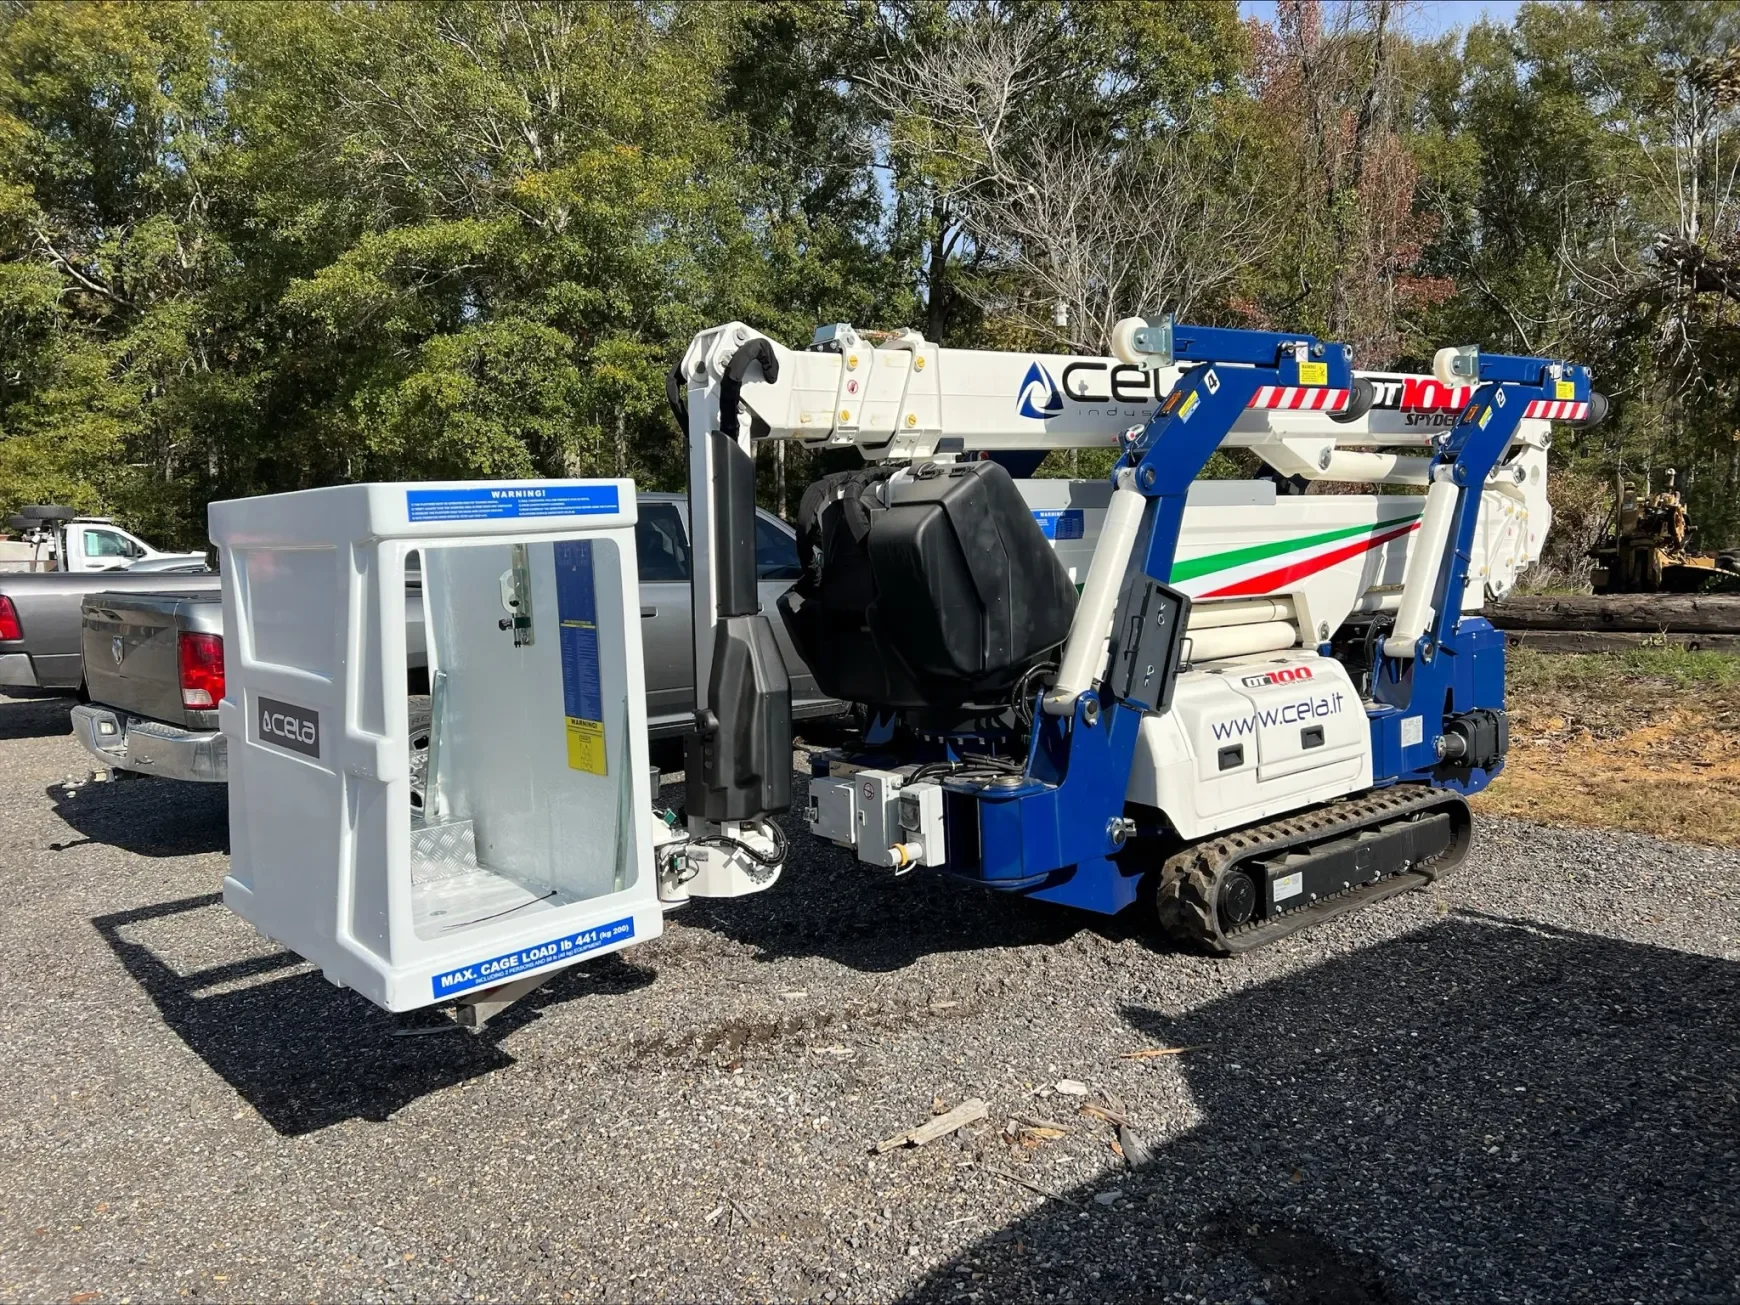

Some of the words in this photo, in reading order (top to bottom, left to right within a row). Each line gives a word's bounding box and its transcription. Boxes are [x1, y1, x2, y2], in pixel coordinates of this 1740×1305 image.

[1062, 361, 1194, 403] cel
[1208, 373, 1217, 389] 4
[1498, 391, 1504, 406] 2
[491, 489, 546, 499] WARNING!
[570, 719, 598, 728] WARNING!
[1212, 692, 1343, 740] www.cela.it
[441, 968, 478, 988] MAX.
[480, 955, 519, 975] CAGE
[522, 944, 558, 963] LOAD
[575, 931, 597, 946] 441
[599, 930, 612, 940] (kg
[613, 924, 630, 935] 200)
[475, 971, 504, 984] INCLUDING
[509, 962, 534, 975] PERSONS
[534, 957, 546, 967] AND
[573, 941, 602, 954] EQUIPMENT
